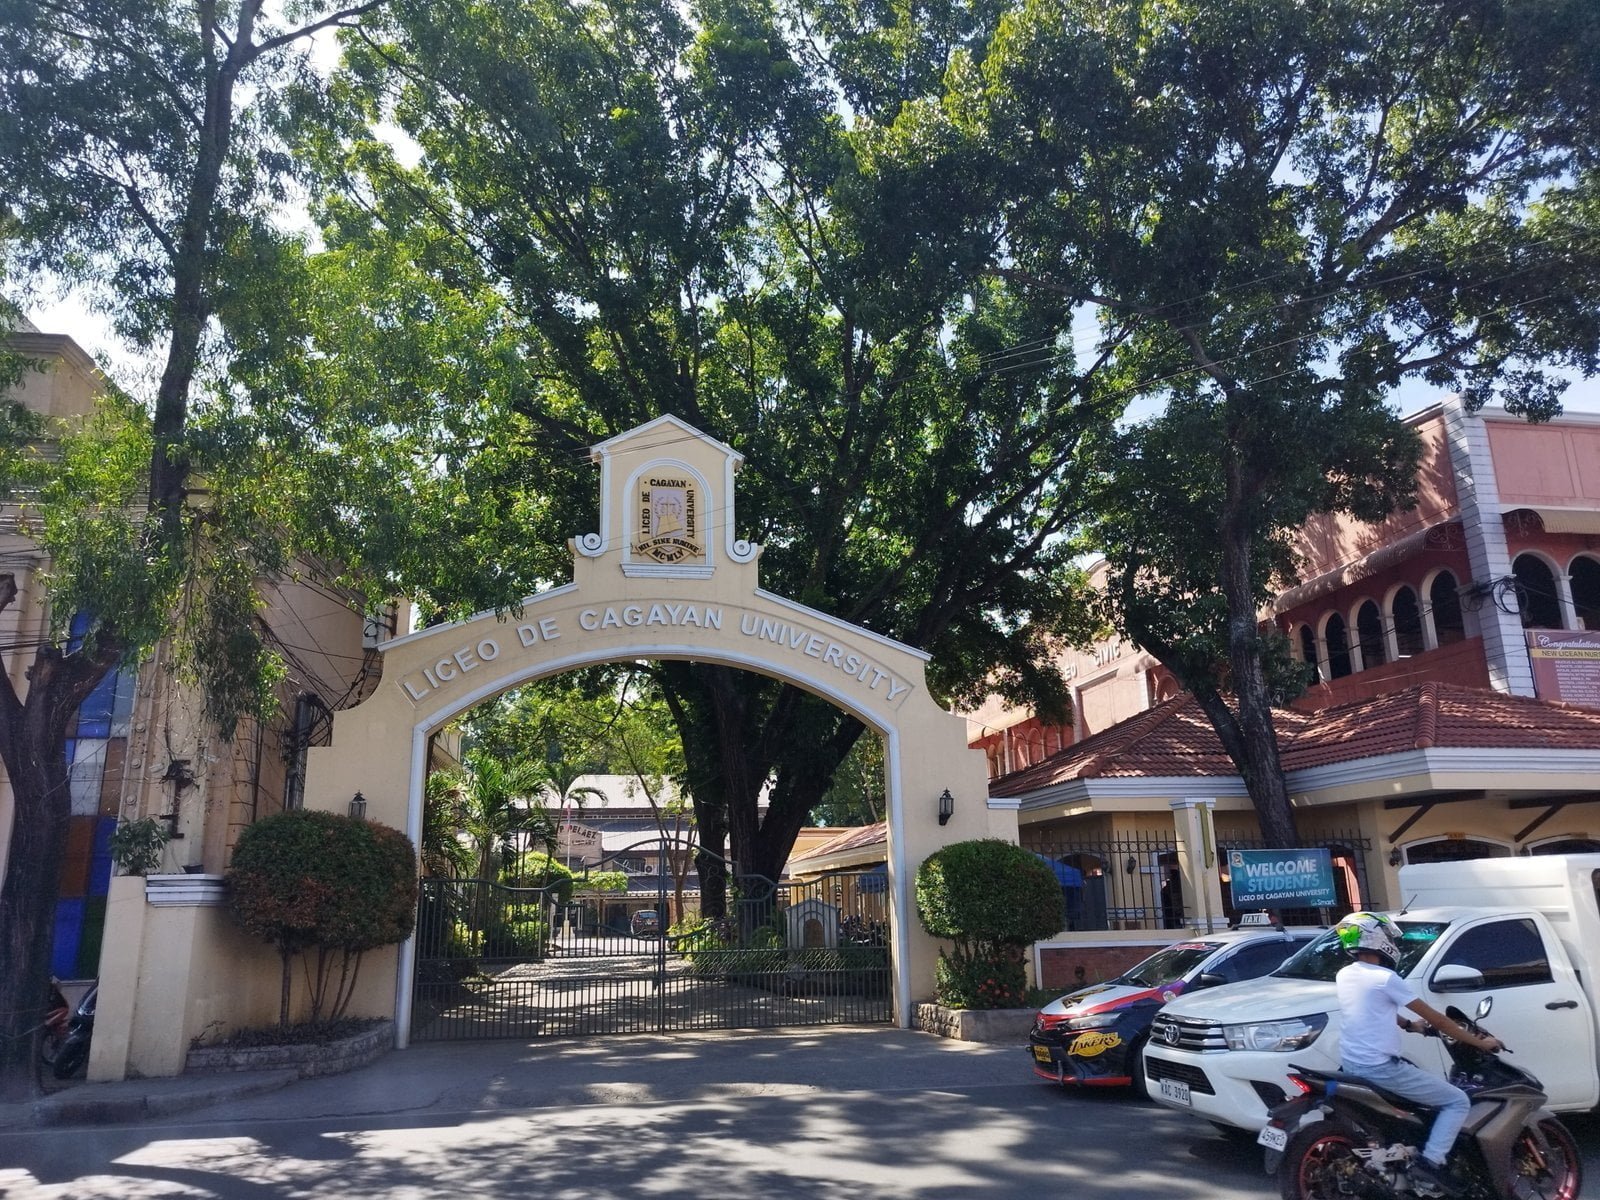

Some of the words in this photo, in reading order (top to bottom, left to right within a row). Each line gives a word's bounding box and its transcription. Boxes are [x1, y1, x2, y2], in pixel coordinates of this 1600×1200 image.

[650, 478, 687, 488] CAGAYAN
[641, 491, 651, 503] DE
[641, 508, 651, 534] LICEO
[686, 489, 695, 539] UNIVERSITY
[652, 548, 685, 562] MCMLV
[403, 638, 500, 701] LICEO
[516, 617, 562, 648] DE
[579, 604, 723, 631] CAGAYAN
[740, 613, 907, 701] UNIVERSITY
[1559, 650, 1584, 658] LICEAN
[568, 825, 597, 839] PELAEZ
[1246, 858, 1317, 878] WELCOME
[1247, 874, 1320, 892] STUDENTS
[1239, 893, 1255, 902] LICEO
[1266, 891, 1295, 900] CAGAYAN
[1296, 888, 1330, 897] UNIVERSITY
[1317, 898, 1335, 906] Smart
[1244, 915, 1261, 924] TAXI
